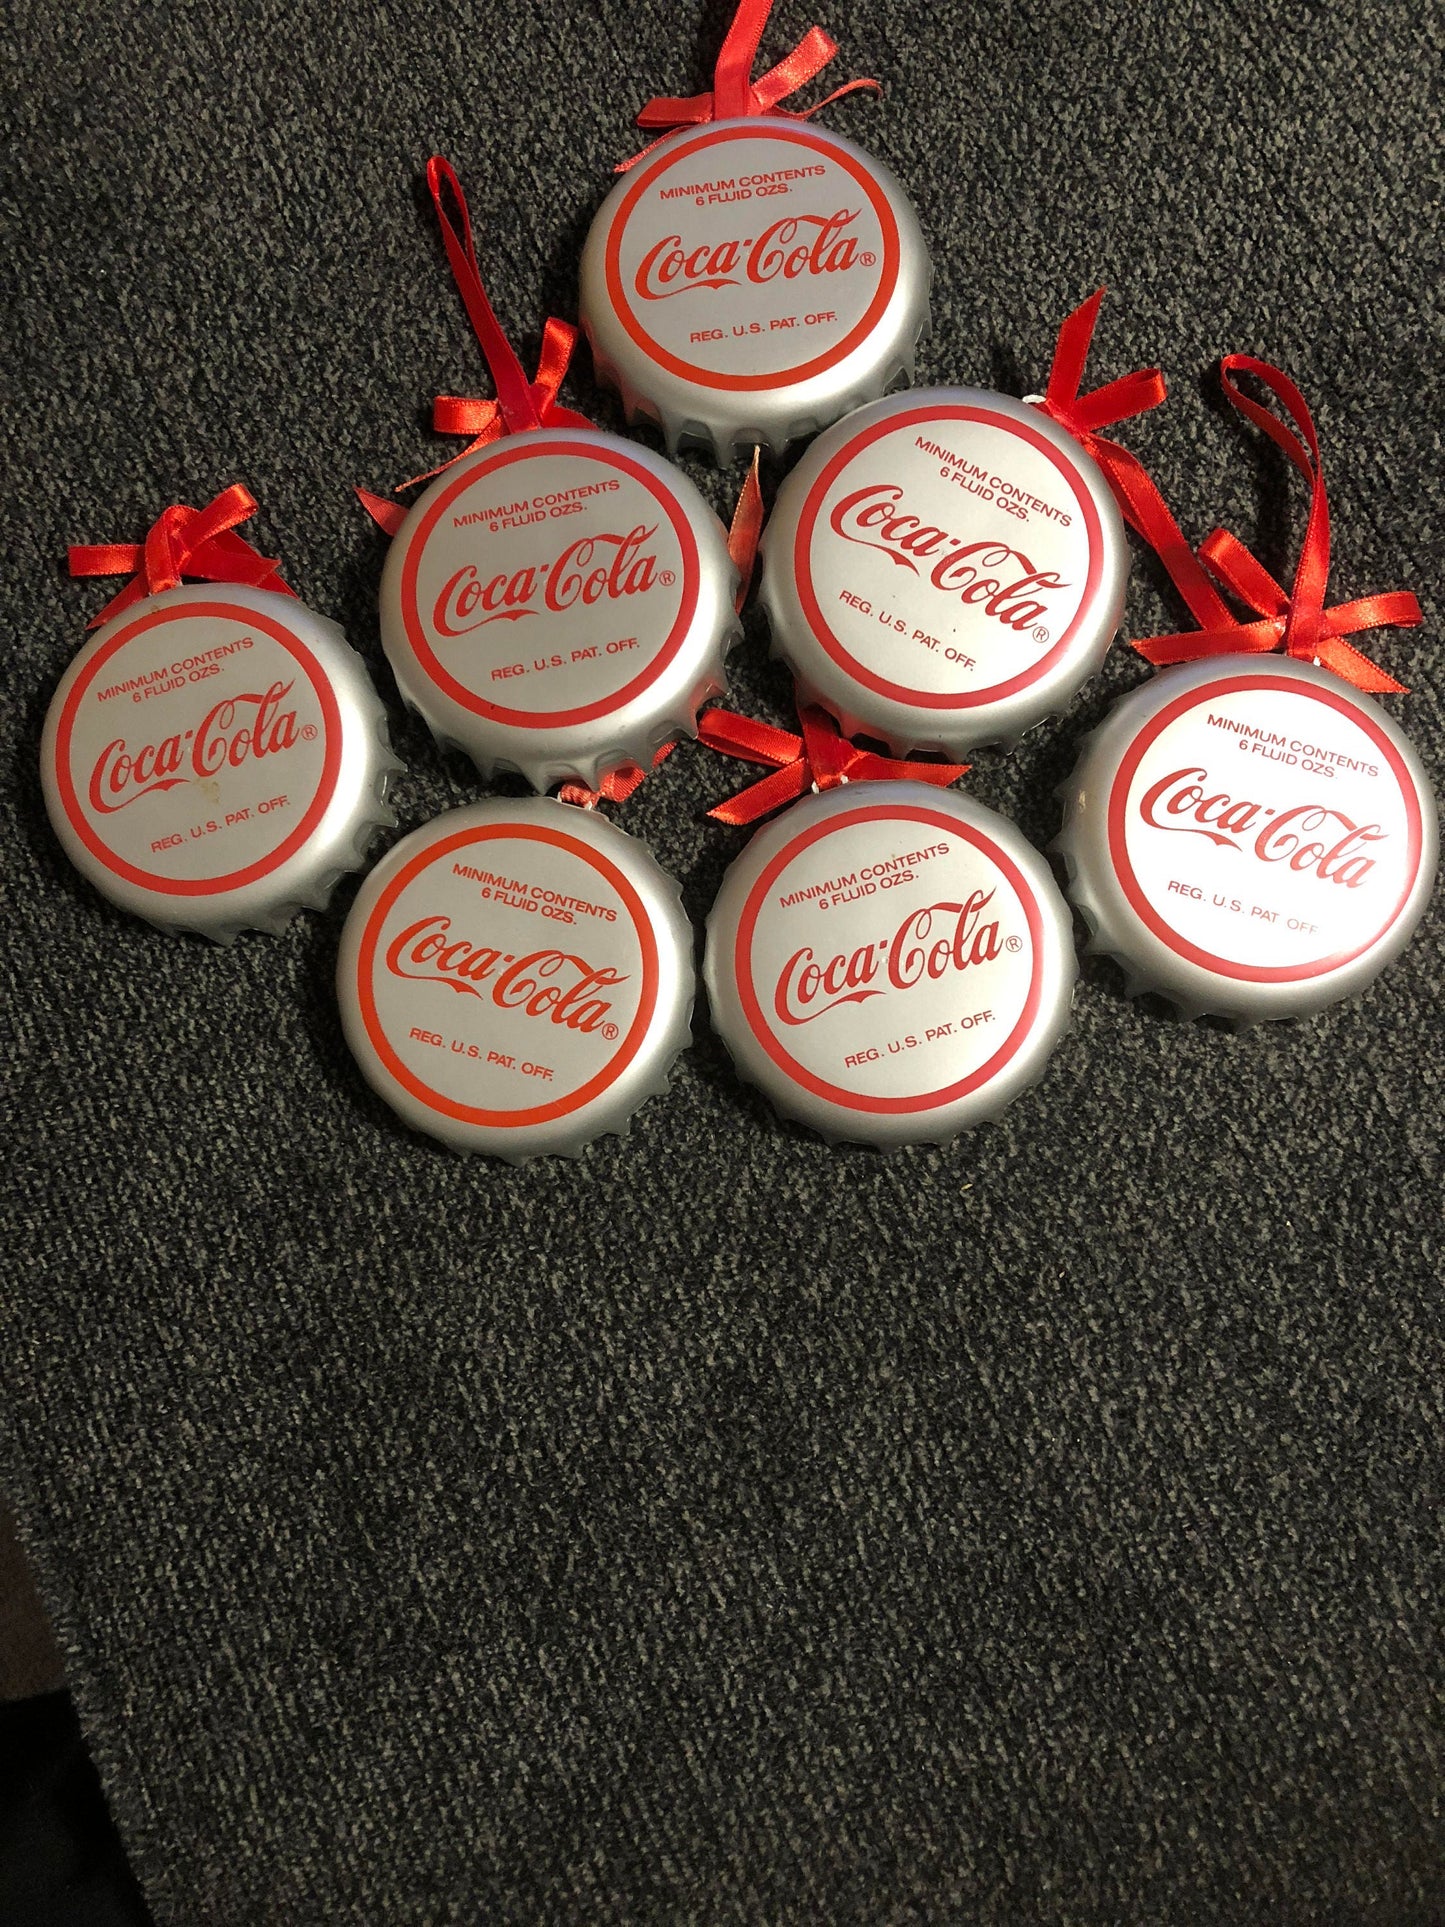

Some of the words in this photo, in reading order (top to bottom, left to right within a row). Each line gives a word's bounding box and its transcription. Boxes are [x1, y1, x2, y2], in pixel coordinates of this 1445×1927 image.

[659, 178, 735, 200] MINIMUM
[739, 165, 826, 187] CONTENTS
[696, 196, 705, 206] 6
[709, 188, 751, 204] FLUID
[915, 436, 988, 482] MINIMUM
[989, 477, 1073, 527] CONTENTS
[940, 466, 950, 477] 6
[951, 472, 994, 501] FLUID
[453, 501, 528, 527] MINIMUM
[533, 480, 620, 507] CONTENTS
[489, 522, 499, 532] 6
[502, 511, 546, 529] FLUID
[97, 668, 168, 702] MINIMUM
[171, 637, 254, 675] CONTENTS
[132, 692, 142, 703] 6
[144, 676, 185, 700] FLUID
[1207, 714, 1286, 747] MINIMUM
[1290, 741, 1379, 777] CONTENTS
[1239, 739, 1249, 750] 6
[1251, 743, 1298, 765] FLUID
[453, 864, 528, 894] MINIMUM
[531, 887, 617, 922] CONTENTS
[779, 873, 857, 908] MINIMUM
[860, 843, 950, 881] CONTENTS
[481, 888, 491, 898] 6
[494, 891, 537, 912] FLUID
[819, 899, 829, 910] 6
[832, 882, 877, 906] FLUID
